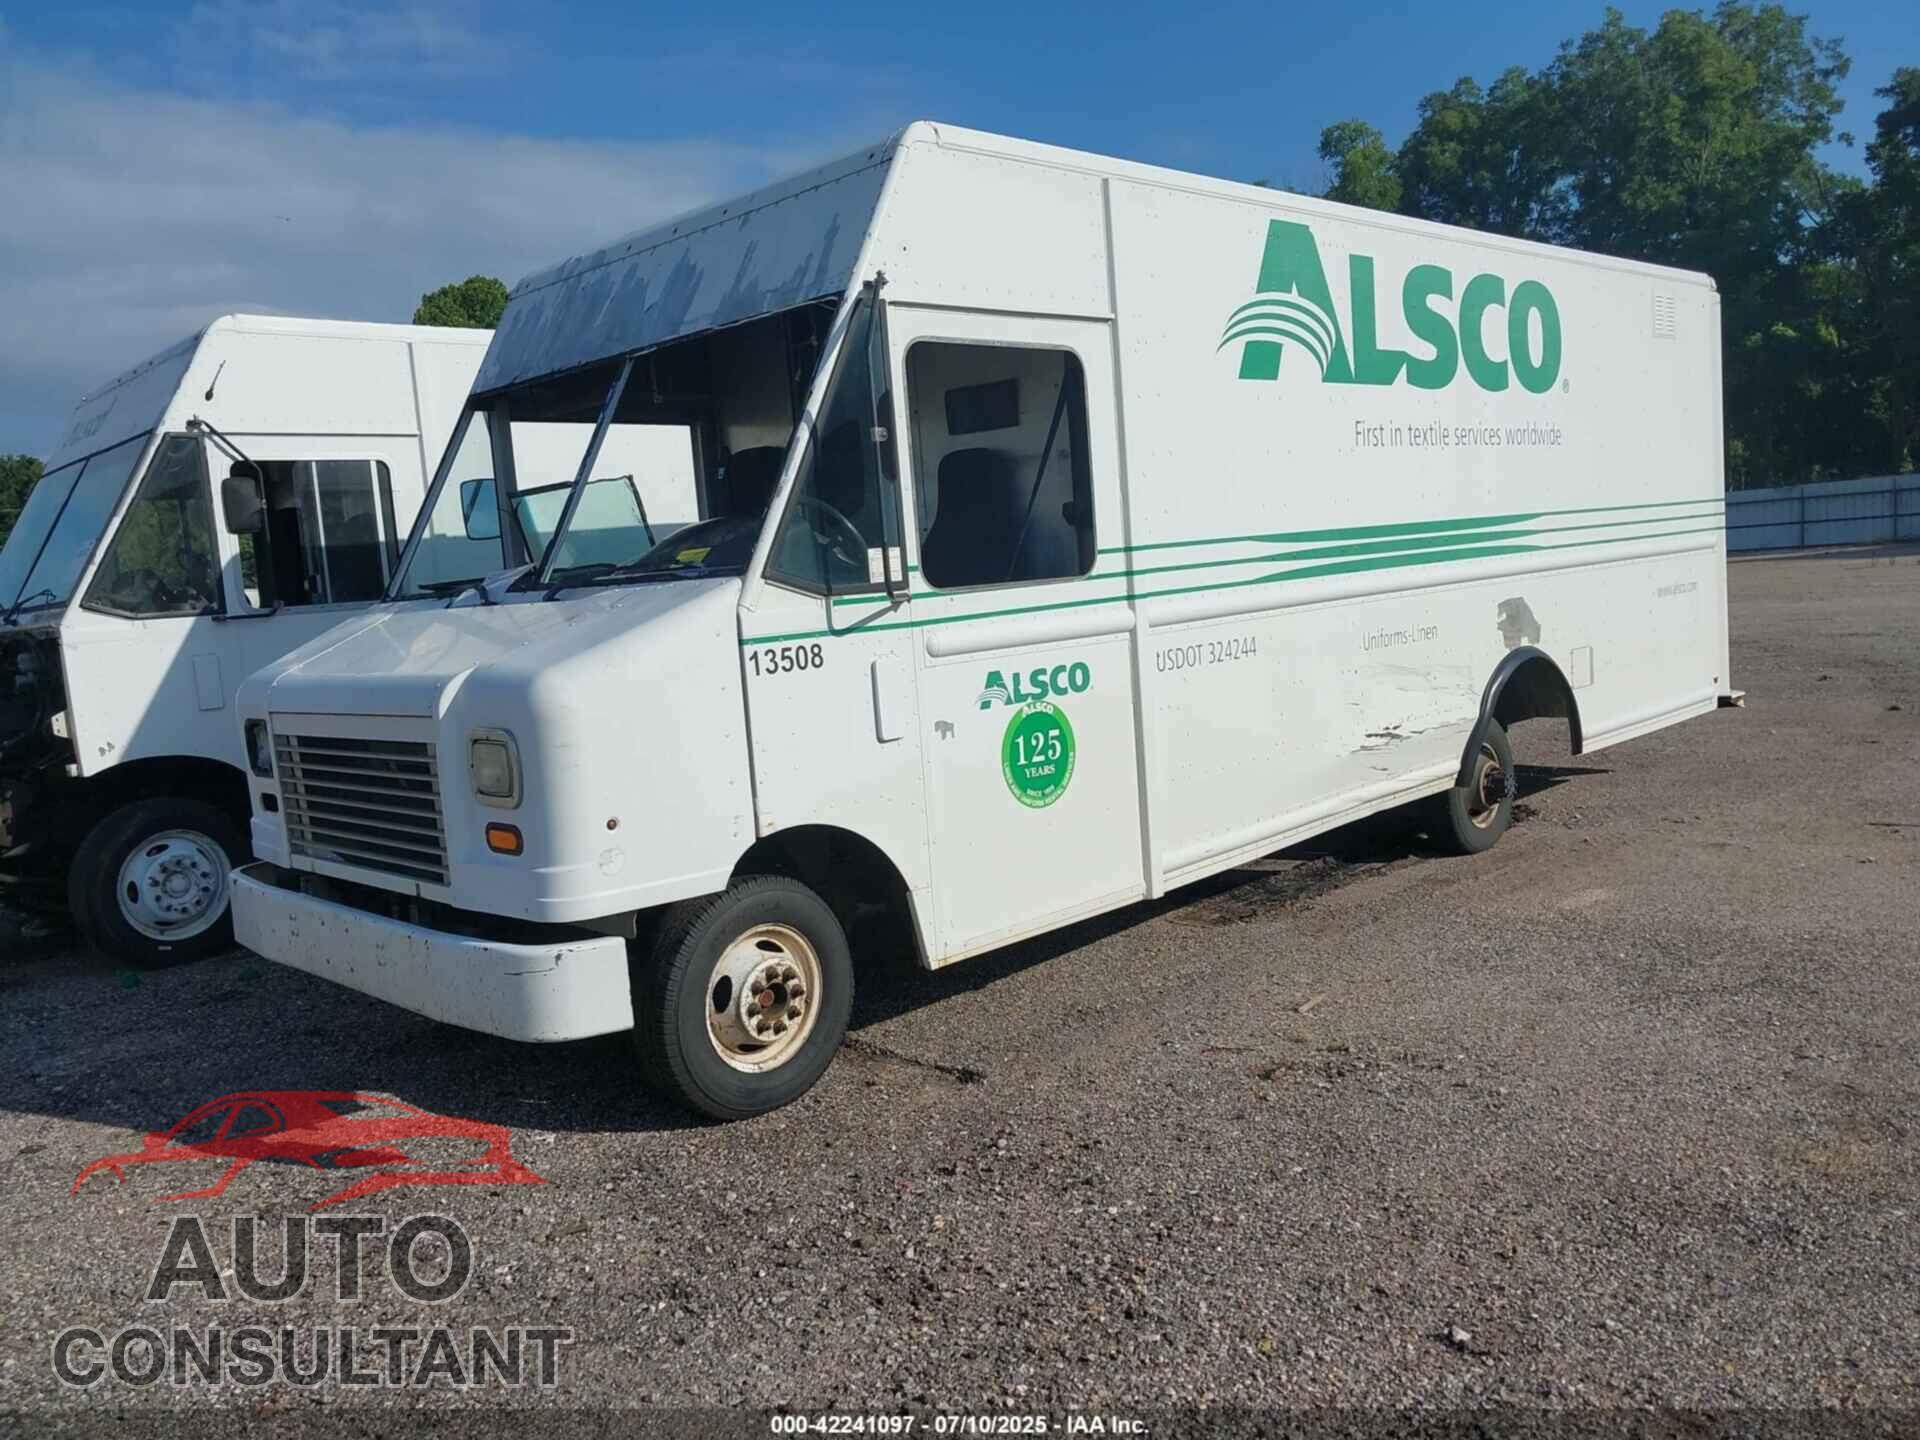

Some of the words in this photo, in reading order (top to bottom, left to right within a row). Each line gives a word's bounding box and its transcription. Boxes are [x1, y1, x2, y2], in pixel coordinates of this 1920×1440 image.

[1217, 219, 1562, 395] ALSCO
[1354, 420, 1385, 447] First
[1389, 419, 1402, 447] in
[1407, 420, 1450, 447] textile
[1454, 421, 1501, 447] services
[1504, 421, 1562, 447] worldwide
[1156, 643, 1203, 672] USDOT
[1207, 636, 1257, 664] 324244
[1362, 624, 1438, 651] Uniforms-Linen
[749, 643, 824, 676] 13508
[976, 661, 1091, 710] ALSCO
[1014, 729, 1062, 766] 125
[1024, 764, 1056, 779] YEARS
